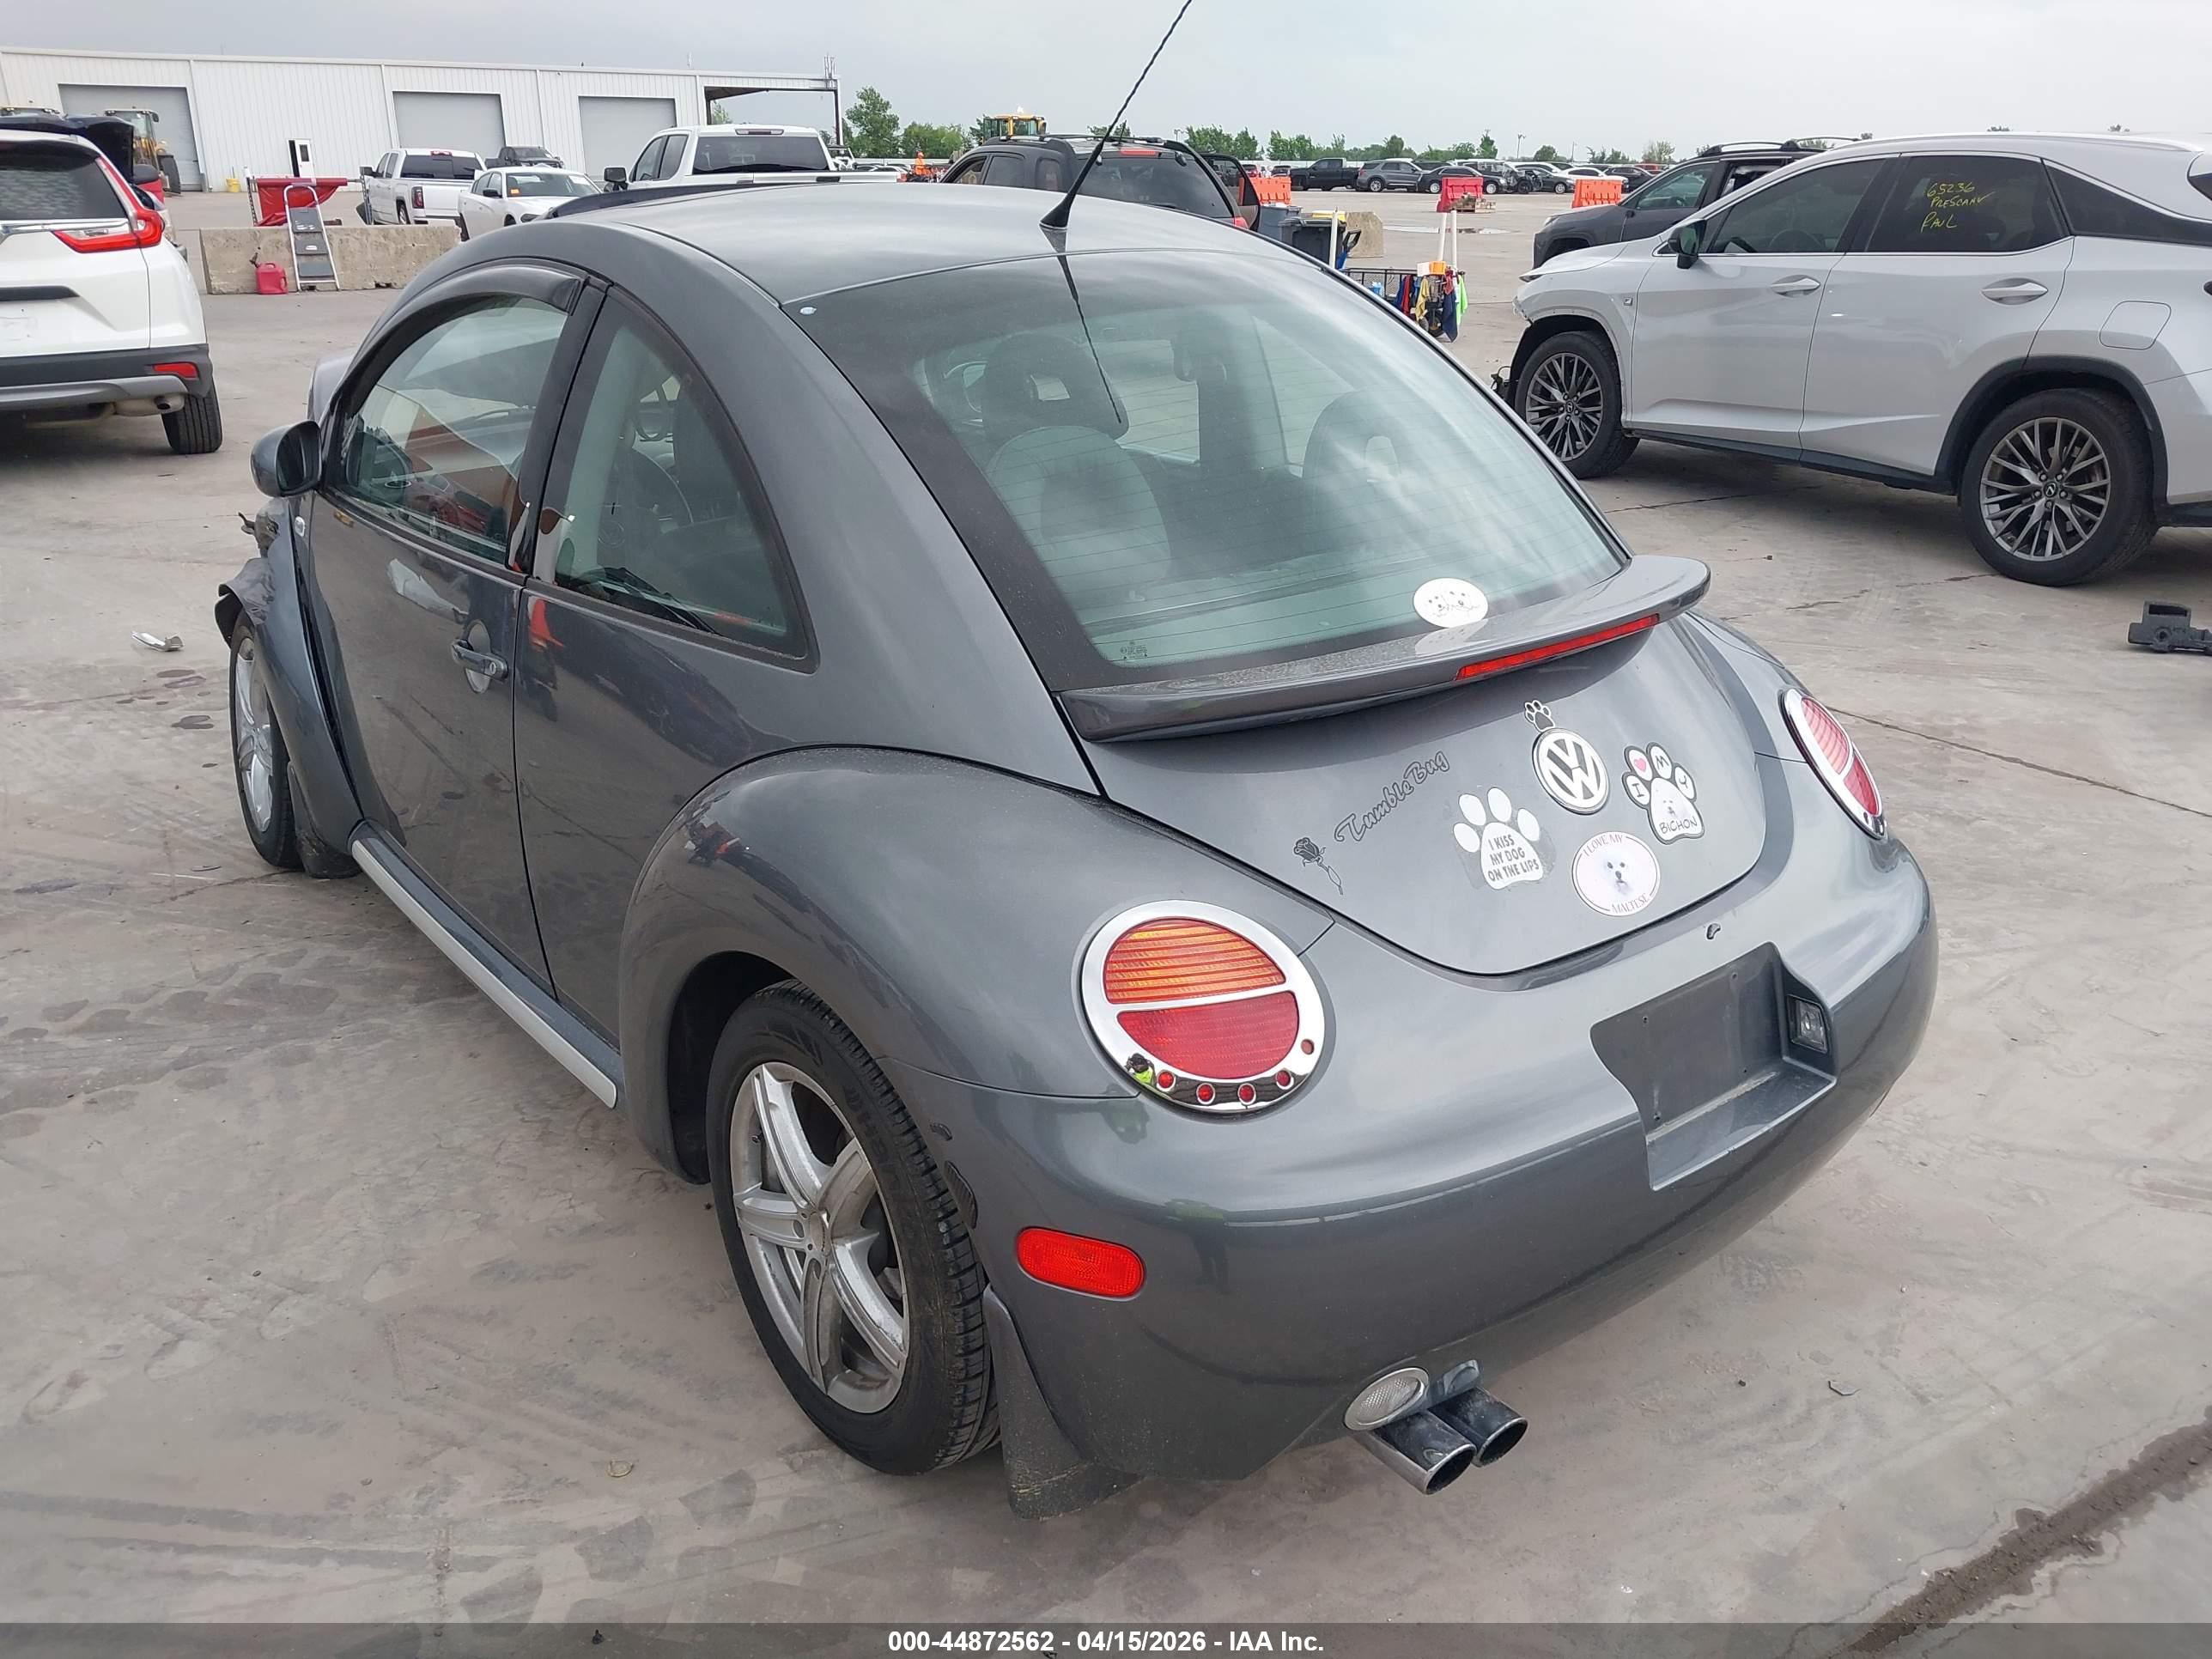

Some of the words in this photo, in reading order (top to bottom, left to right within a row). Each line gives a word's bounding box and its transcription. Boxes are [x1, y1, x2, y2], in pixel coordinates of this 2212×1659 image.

[1927, 182, 1975, 198] 65236
[1659, 816, 1698, 836] BICHON
[1494, 835, 1515, 849] KISS
[1588, 834, 1608, 851] LOVE
[1608, 834, 1623, 845] MY
[1489, 852, 1504, 866] MY
[1505, 847, 1525, 861] DOG
[1487, 869, 1504, 882] ON
[1503, 864, 1521, 878] THE
[1520, 859, 1540, 873] LIPS
[1611, 893, 1650, 914] MALTESE
